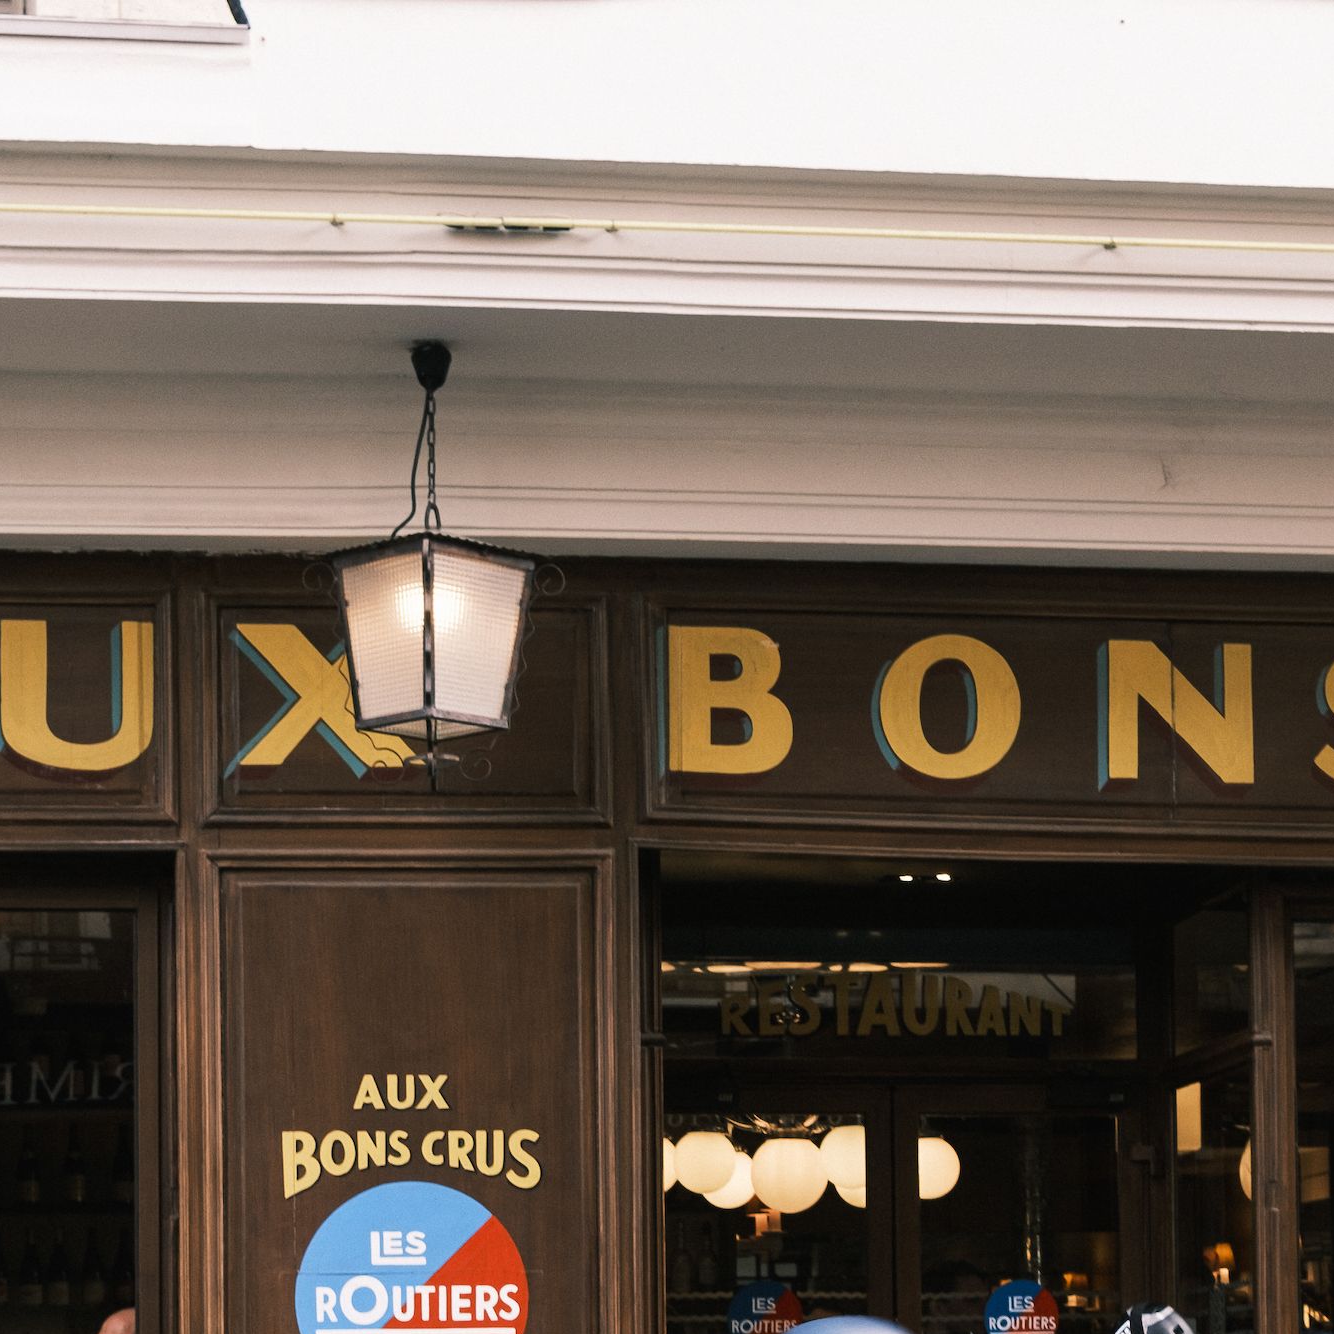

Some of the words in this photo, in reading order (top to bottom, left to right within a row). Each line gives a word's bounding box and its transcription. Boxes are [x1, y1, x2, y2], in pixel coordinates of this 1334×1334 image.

[719, 971, 1074, 1038] RESTAURANT
[354, 1073, 450, 1110] AUX
[281, 1128, 411, 1199] BONS
[421, 1128, 542, 1190] CRUS
[370, 1231, 427, 1266] LES
[315, 1275, 521, 1327] ROUTIERS
[752, 1297, 777, 1314] LES
[1009, 1296, 1034, 1313] LES
[989, 1316, 1057, 1332] ROUTIERS
